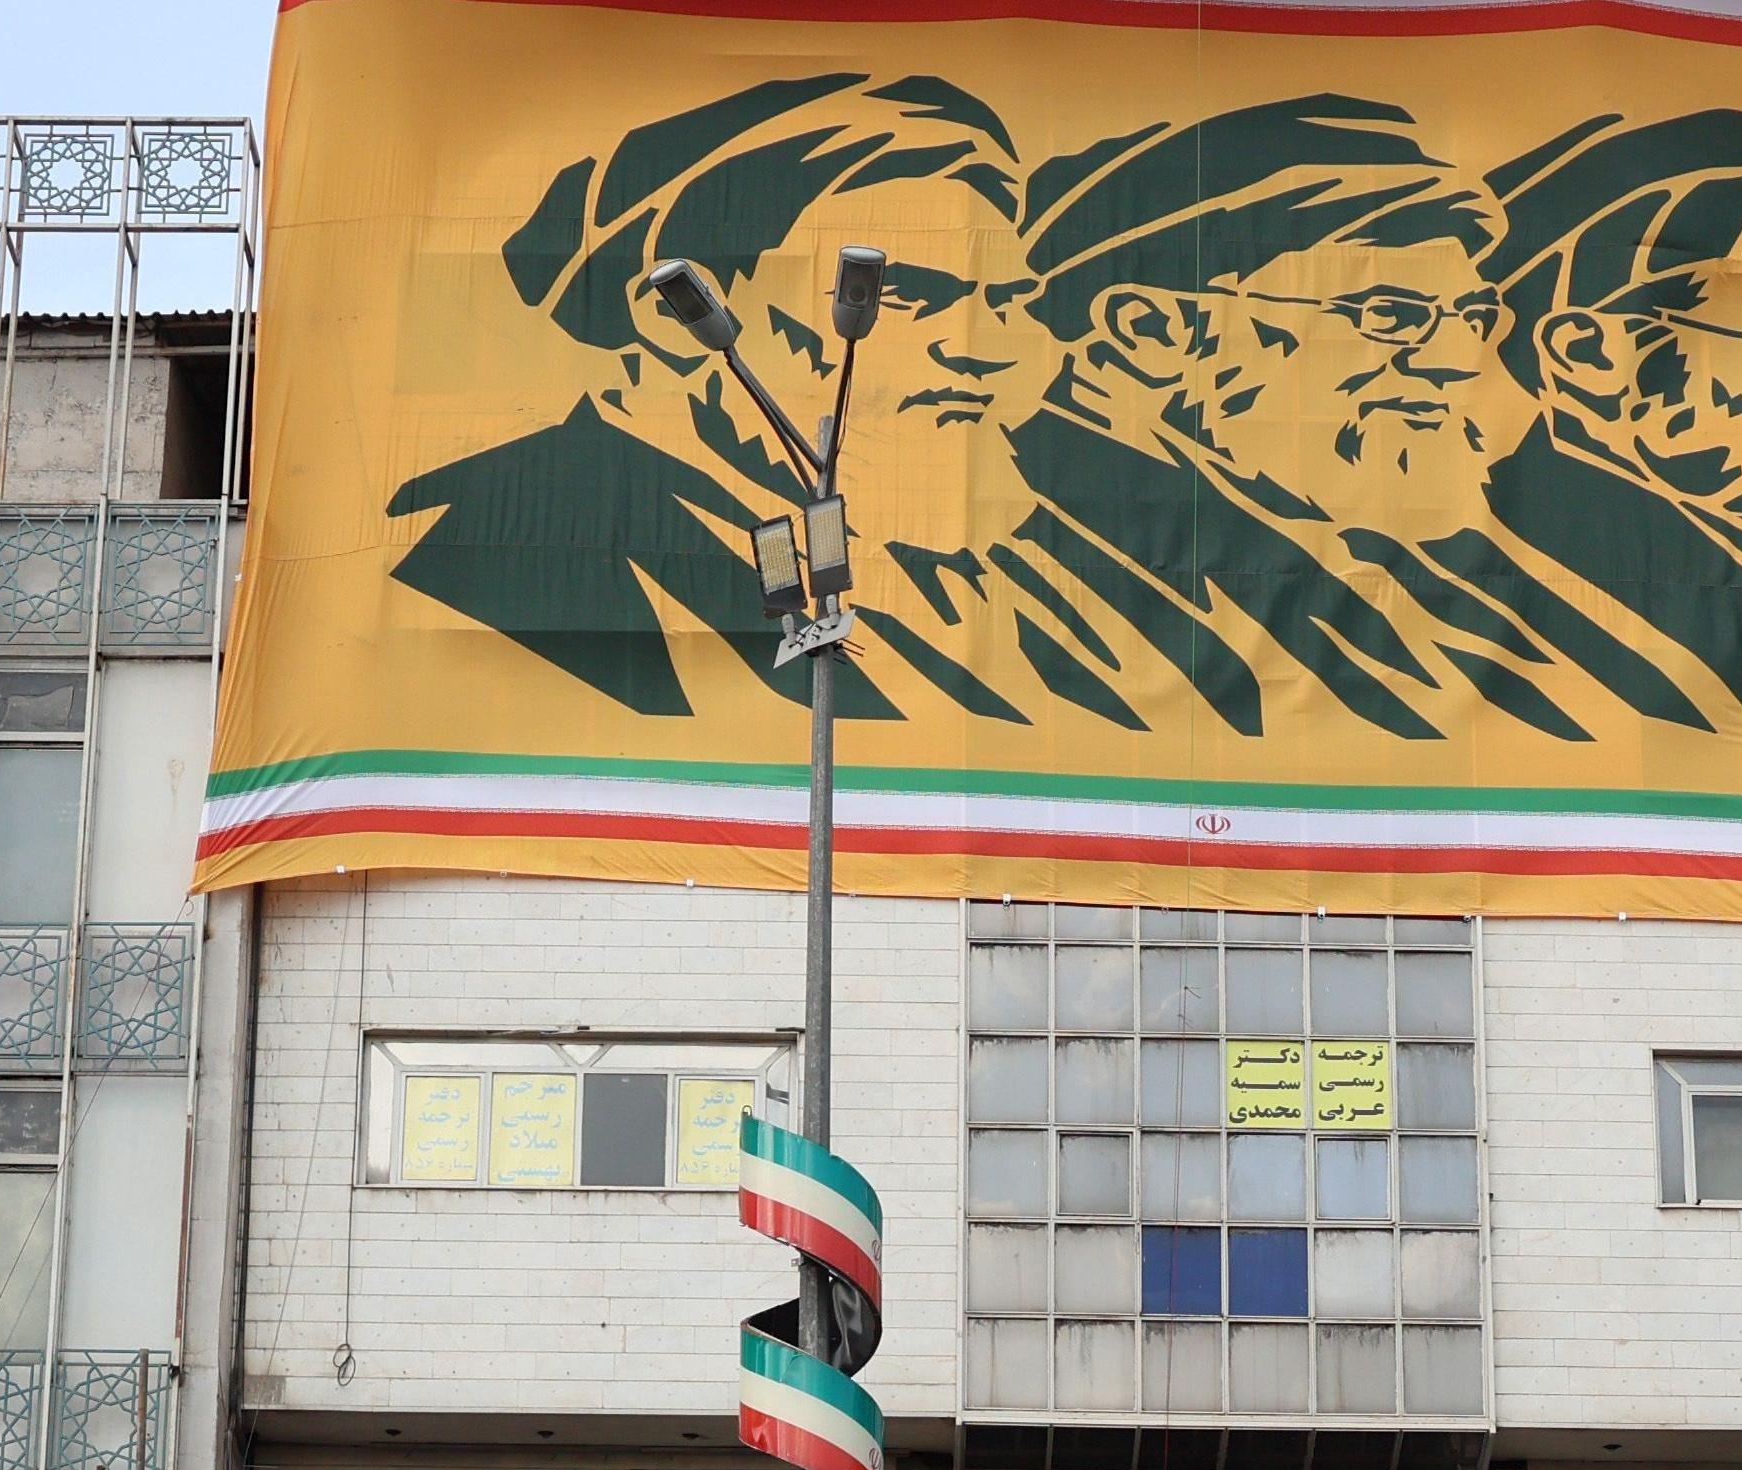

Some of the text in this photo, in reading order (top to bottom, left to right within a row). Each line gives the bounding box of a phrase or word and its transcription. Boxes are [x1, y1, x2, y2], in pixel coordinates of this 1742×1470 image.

[1232, 1047, 1301, 1068] دکتر
[1317, 1045, 1384, 1067] ترجمه
[1230, 1076, 1301, 1094] سمیه
[1318, 1076, 1385, 1093] رسمی
[1228, 1104, 1302, 1124] محمدی
[1318, 1102, 1385, 1122] عربی
